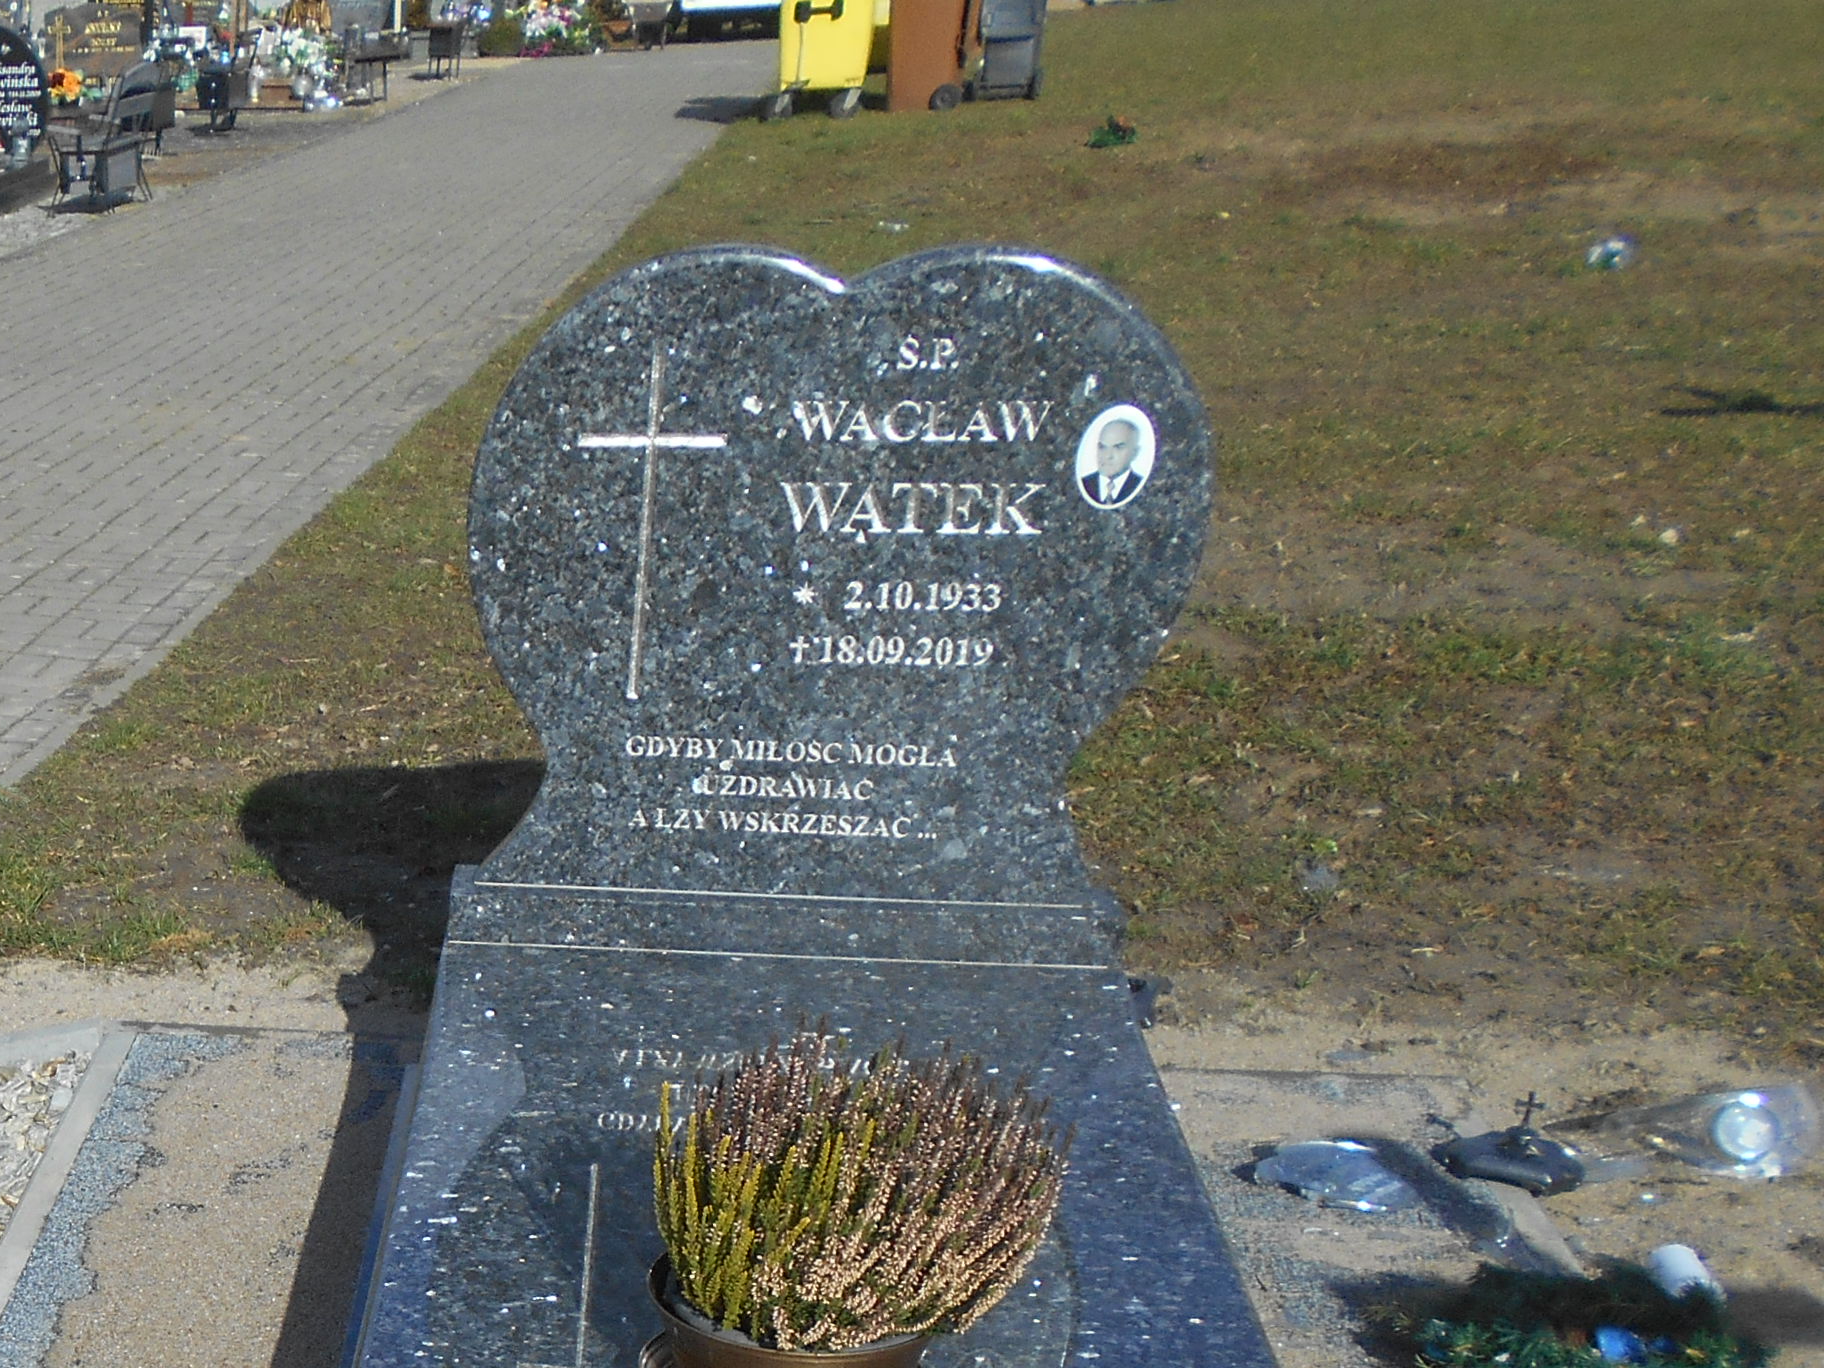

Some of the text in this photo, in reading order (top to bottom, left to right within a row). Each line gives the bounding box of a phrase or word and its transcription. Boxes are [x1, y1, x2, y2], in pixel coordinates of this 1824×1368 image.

[792, 400, 1055, 442] WACŁAW
[843, 580, 1003, 613] 2.10.1933
[625, 735, 724, 760] GDYBY
